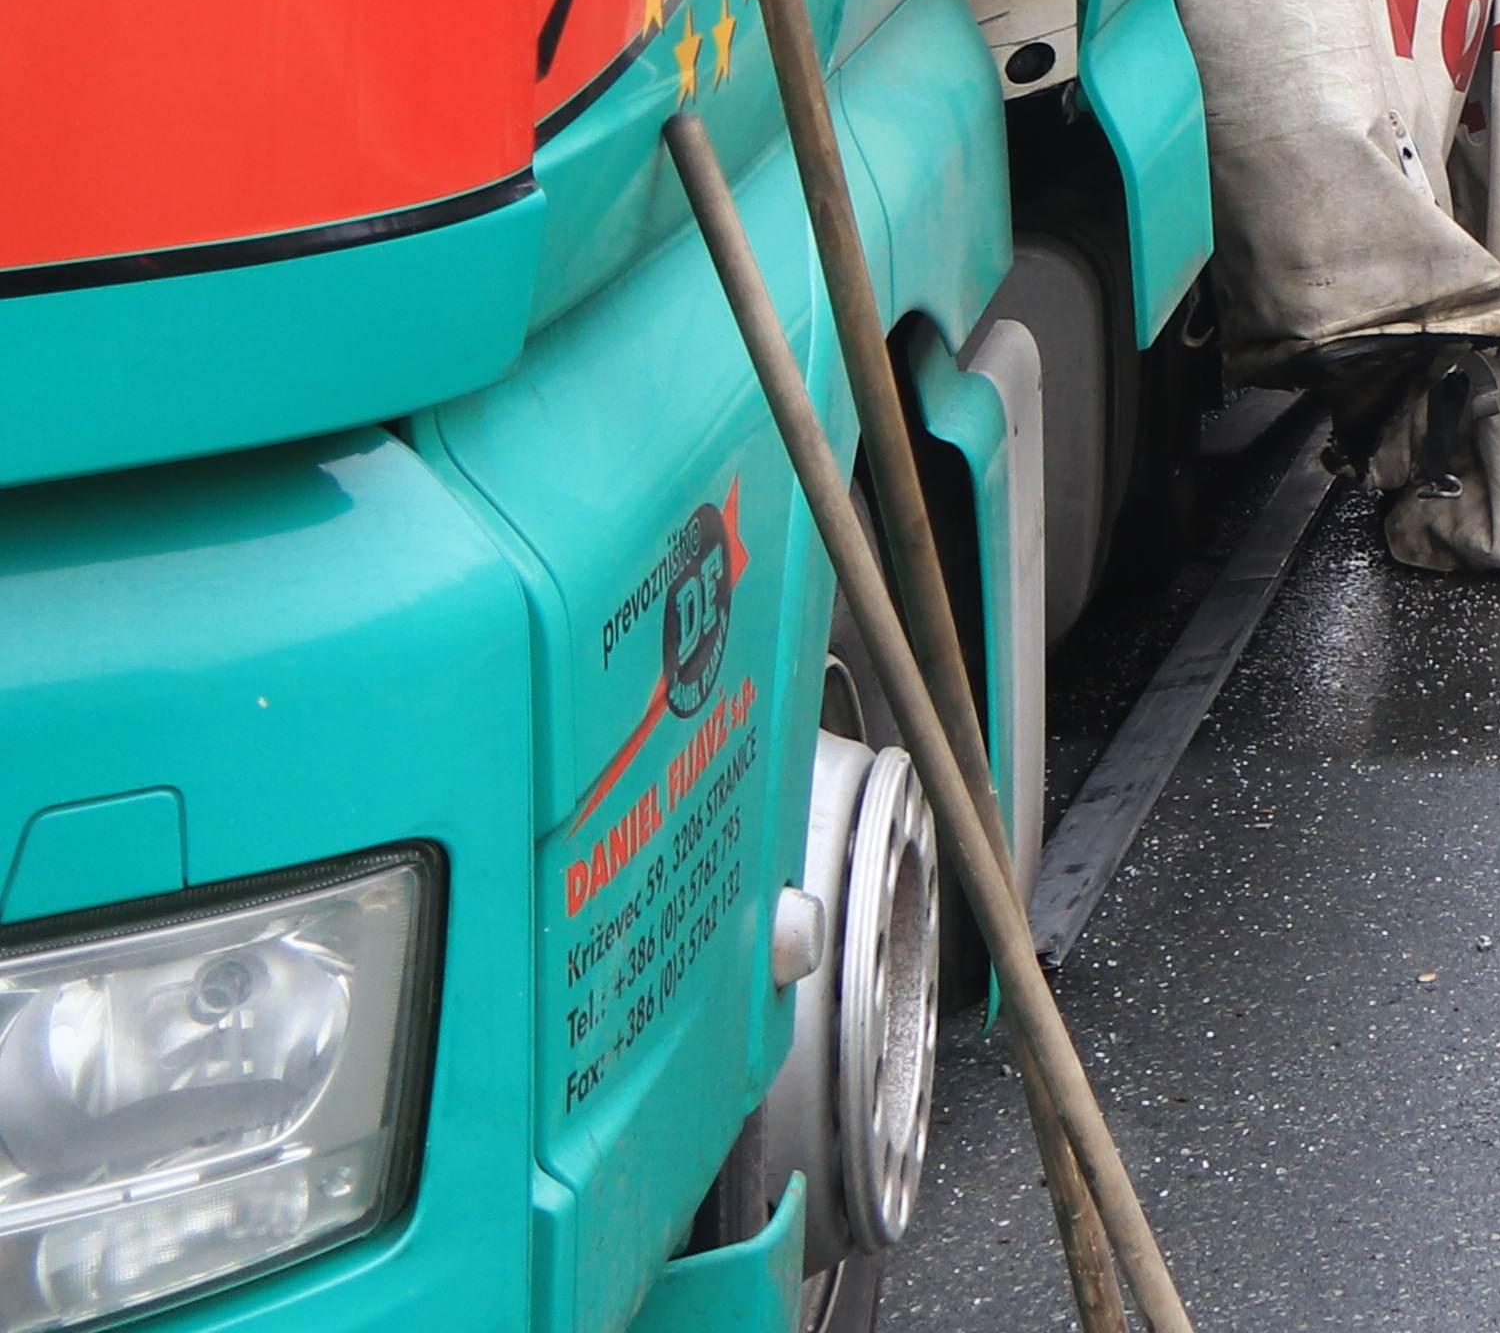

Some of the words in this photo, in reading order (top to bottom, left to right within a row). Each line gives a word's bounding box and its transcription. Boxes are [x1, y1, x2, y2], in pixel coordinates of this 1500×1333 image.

[566, 783, 663, 918] DANIEL
[668, 686, 728, 814] FIJAVŽ
[567, 890, 642, 989] Križevec
[645, 854, 669, 908] 59,
[672, 807, 704, 874] 3206
[706, 725, 758, 828] STRANICE
[614, 925, 656, 999] +386
[689, 840, 718, 908] 5762
[721, 806, 741, 862] 795
[565, 1053, 606, 1115] Fax:
[613, 983, 656, 1060] +386
[689, 893, 718, 966] 5762
[721, 861, 741, 916] 132
